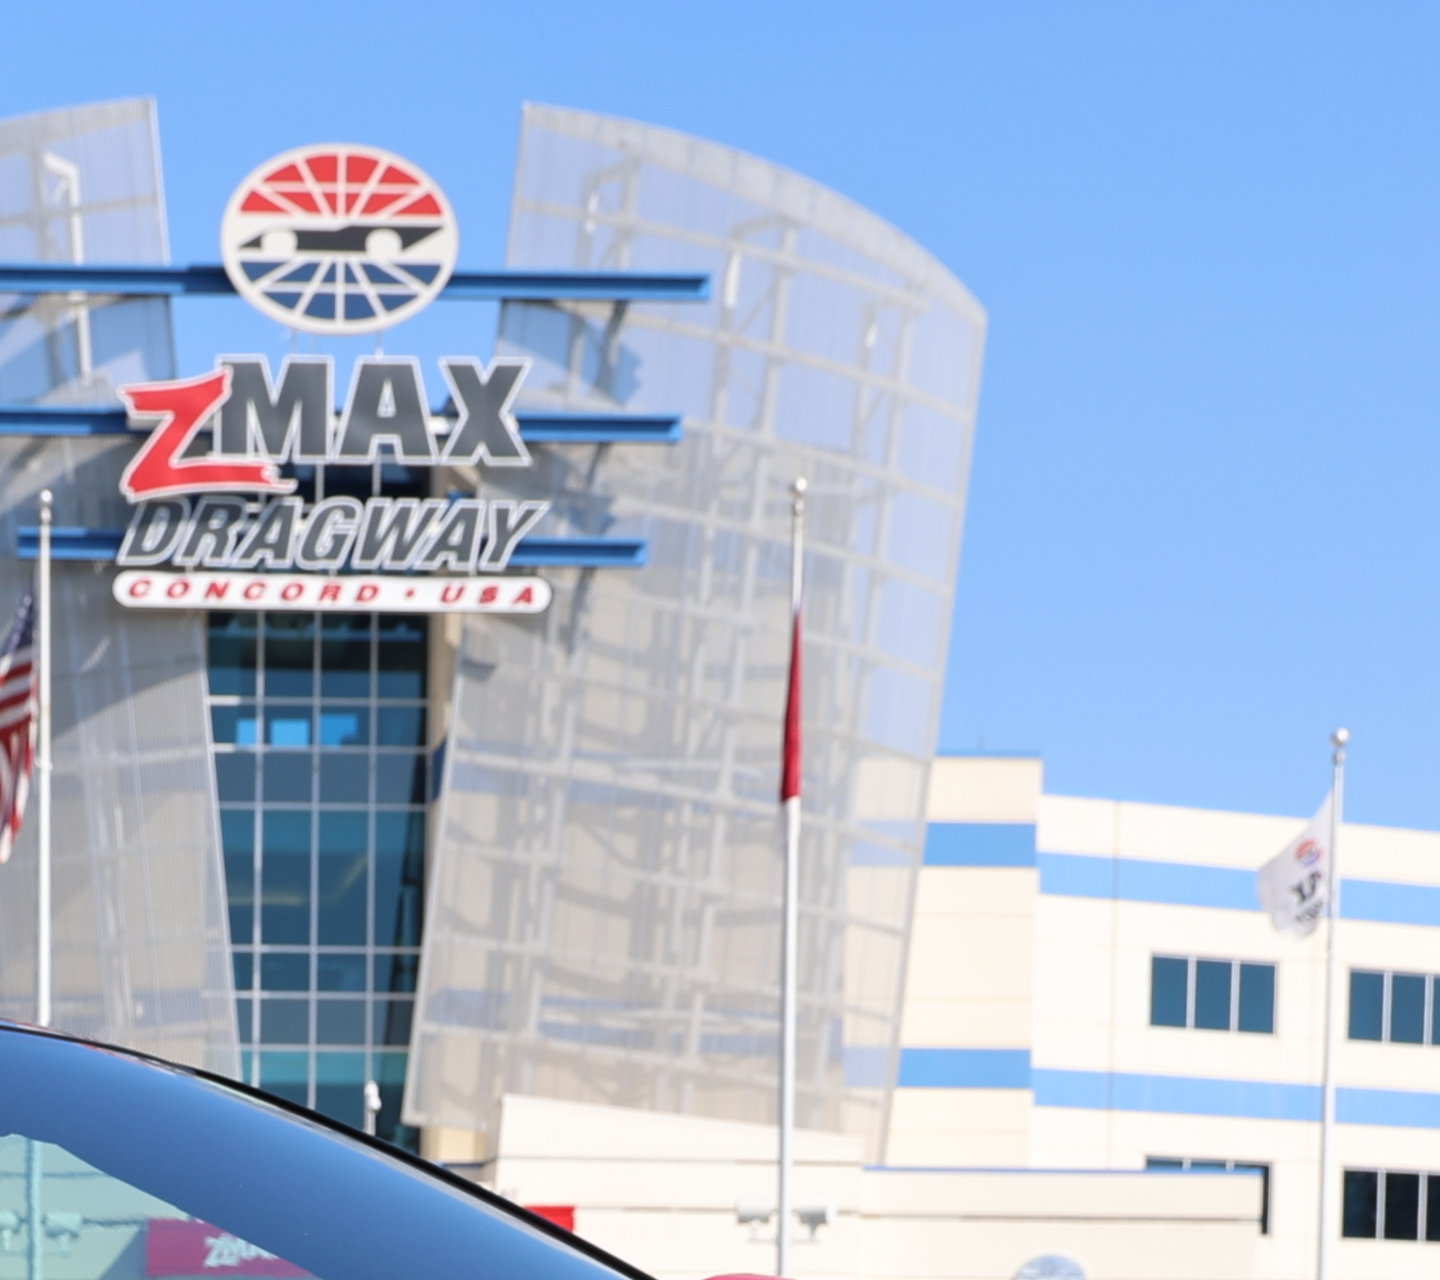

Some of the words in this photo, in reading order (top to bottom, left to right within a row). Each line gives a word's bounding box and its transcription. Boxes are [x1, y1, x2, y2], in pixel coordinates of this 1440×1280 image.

[117, 496, 550, 573] DRAGWAY
[128, 579, 380, 604] CONCORD
[440, 583, 535, 606] USA
